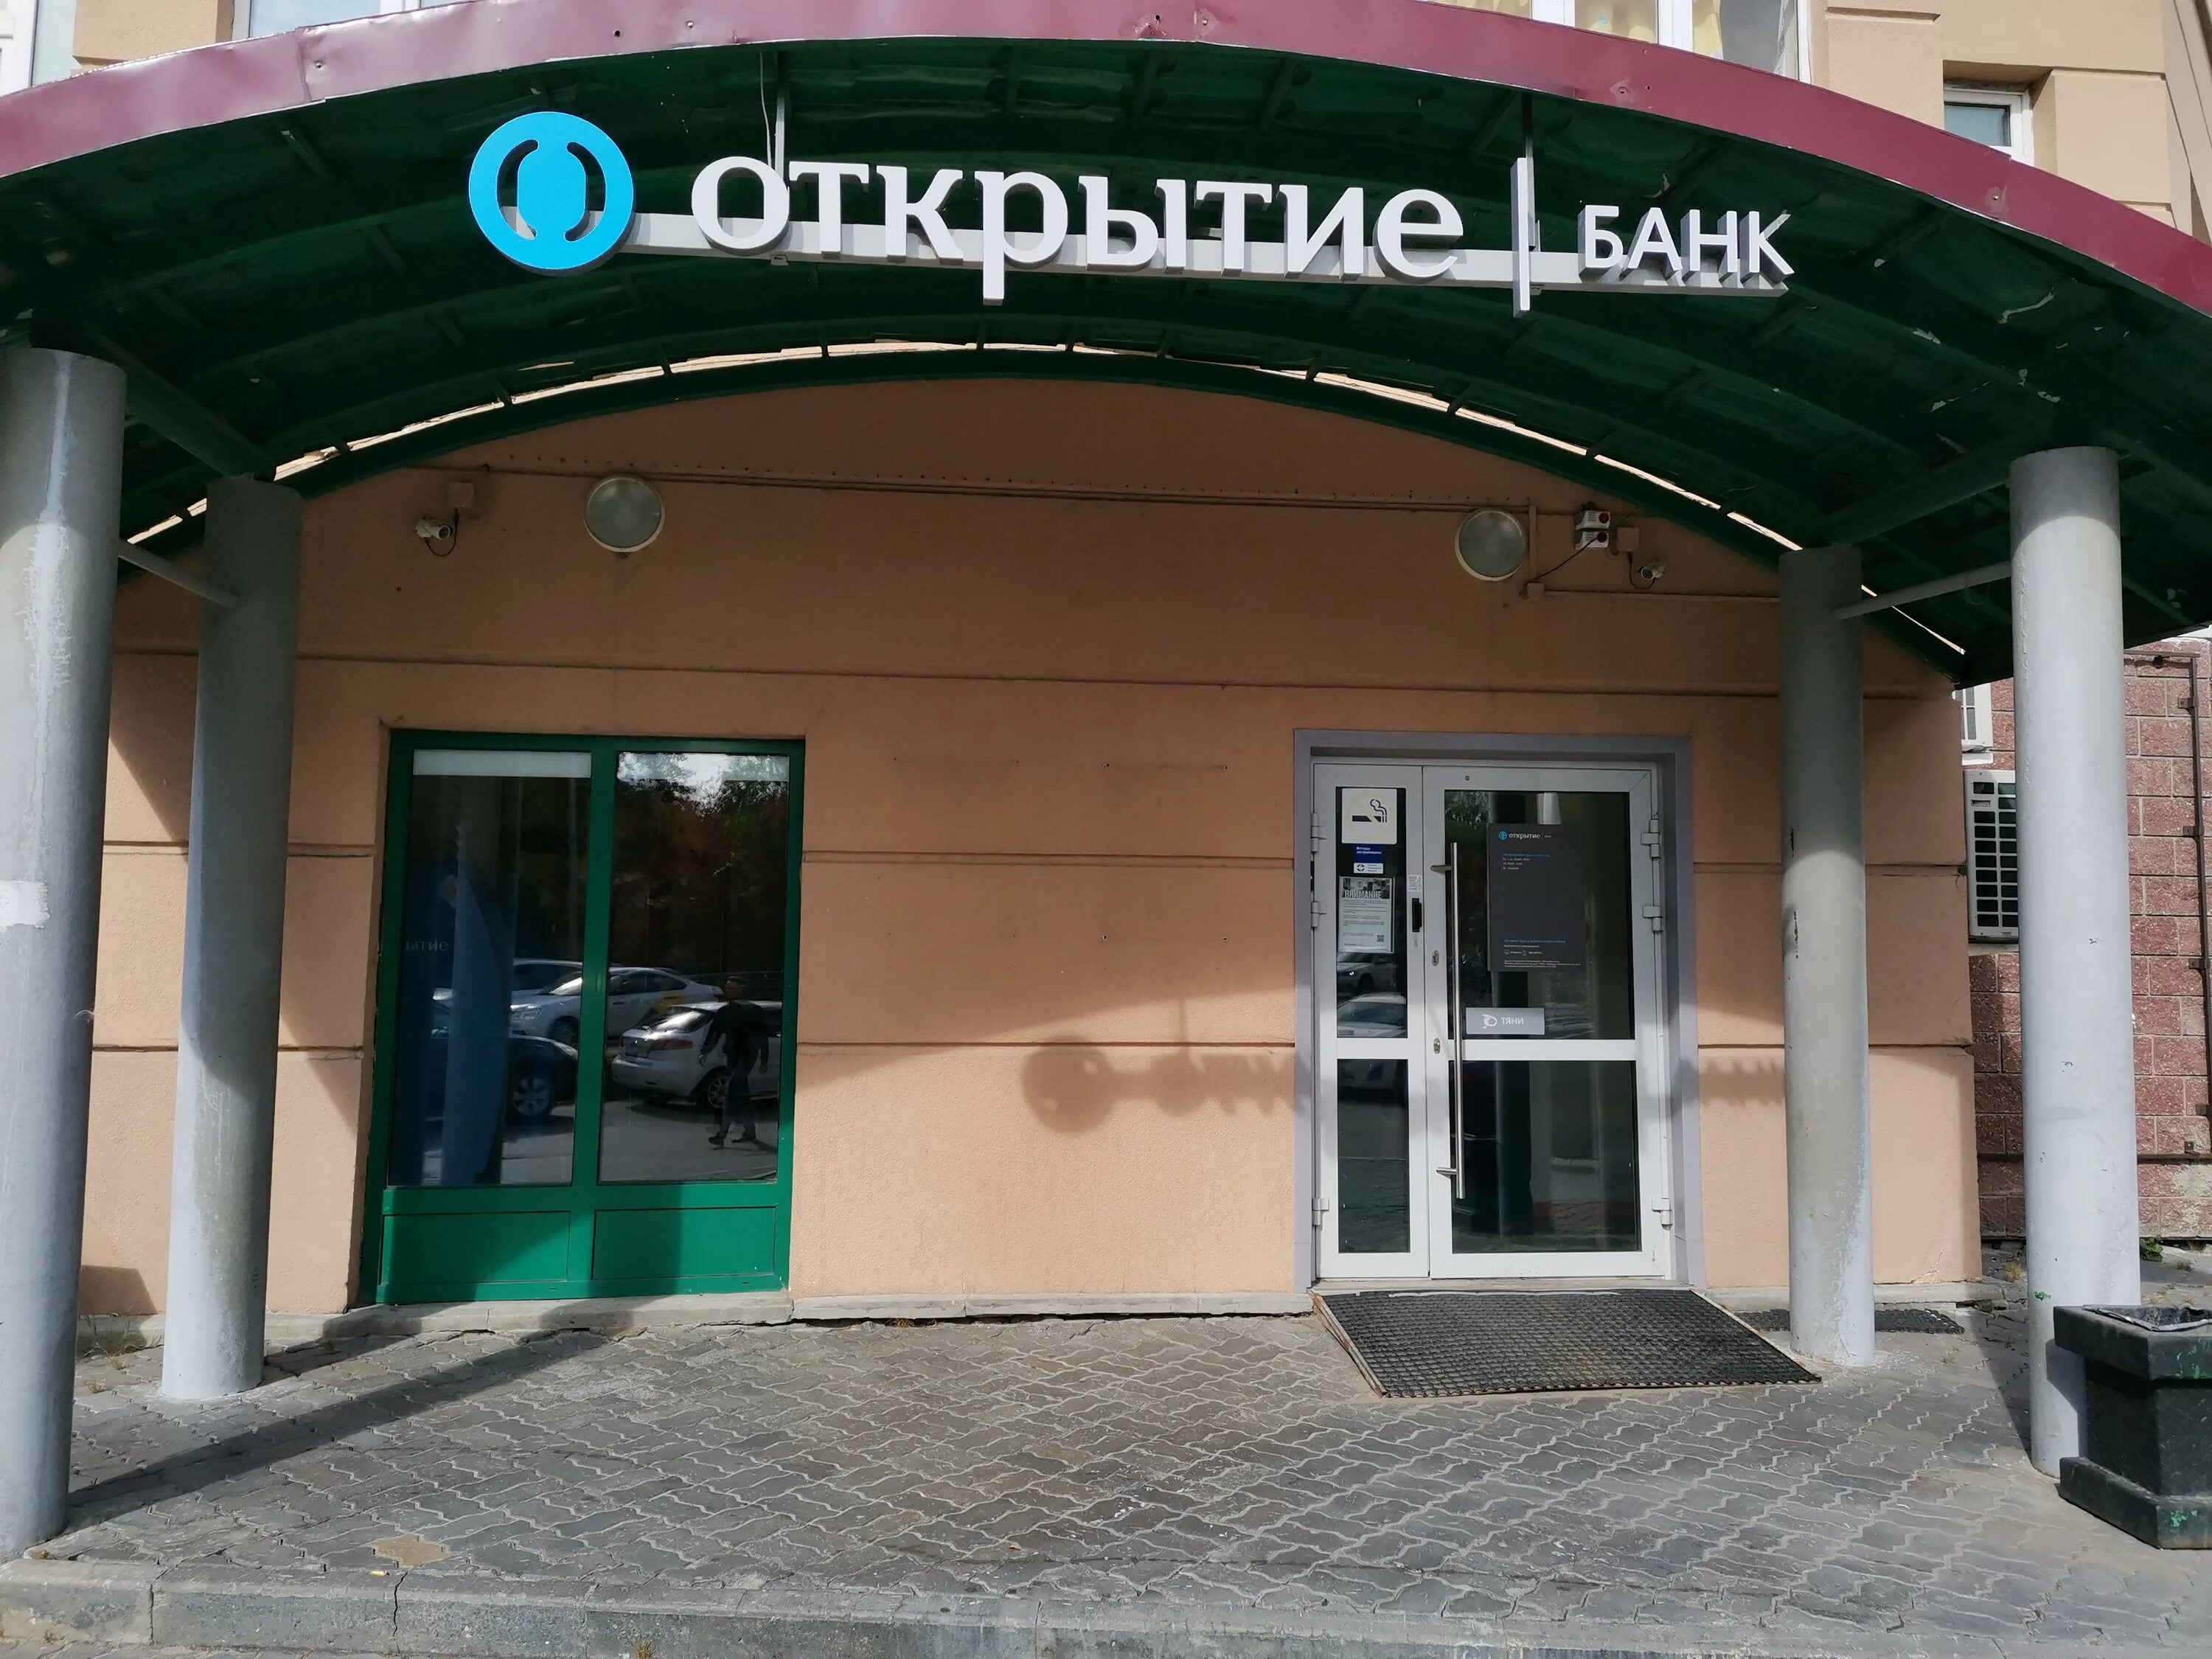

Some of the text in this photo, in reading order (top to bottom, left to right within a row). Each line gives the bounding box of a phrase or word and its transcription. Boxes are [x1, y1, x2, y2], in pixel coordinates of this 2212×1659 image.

[692, 156, 1795, 304] открытие БАНК
[1344, 890, 1382, 899] ВНИМАНИЕ
[1501, 1017, 1524, 1025] ТЯНИ
